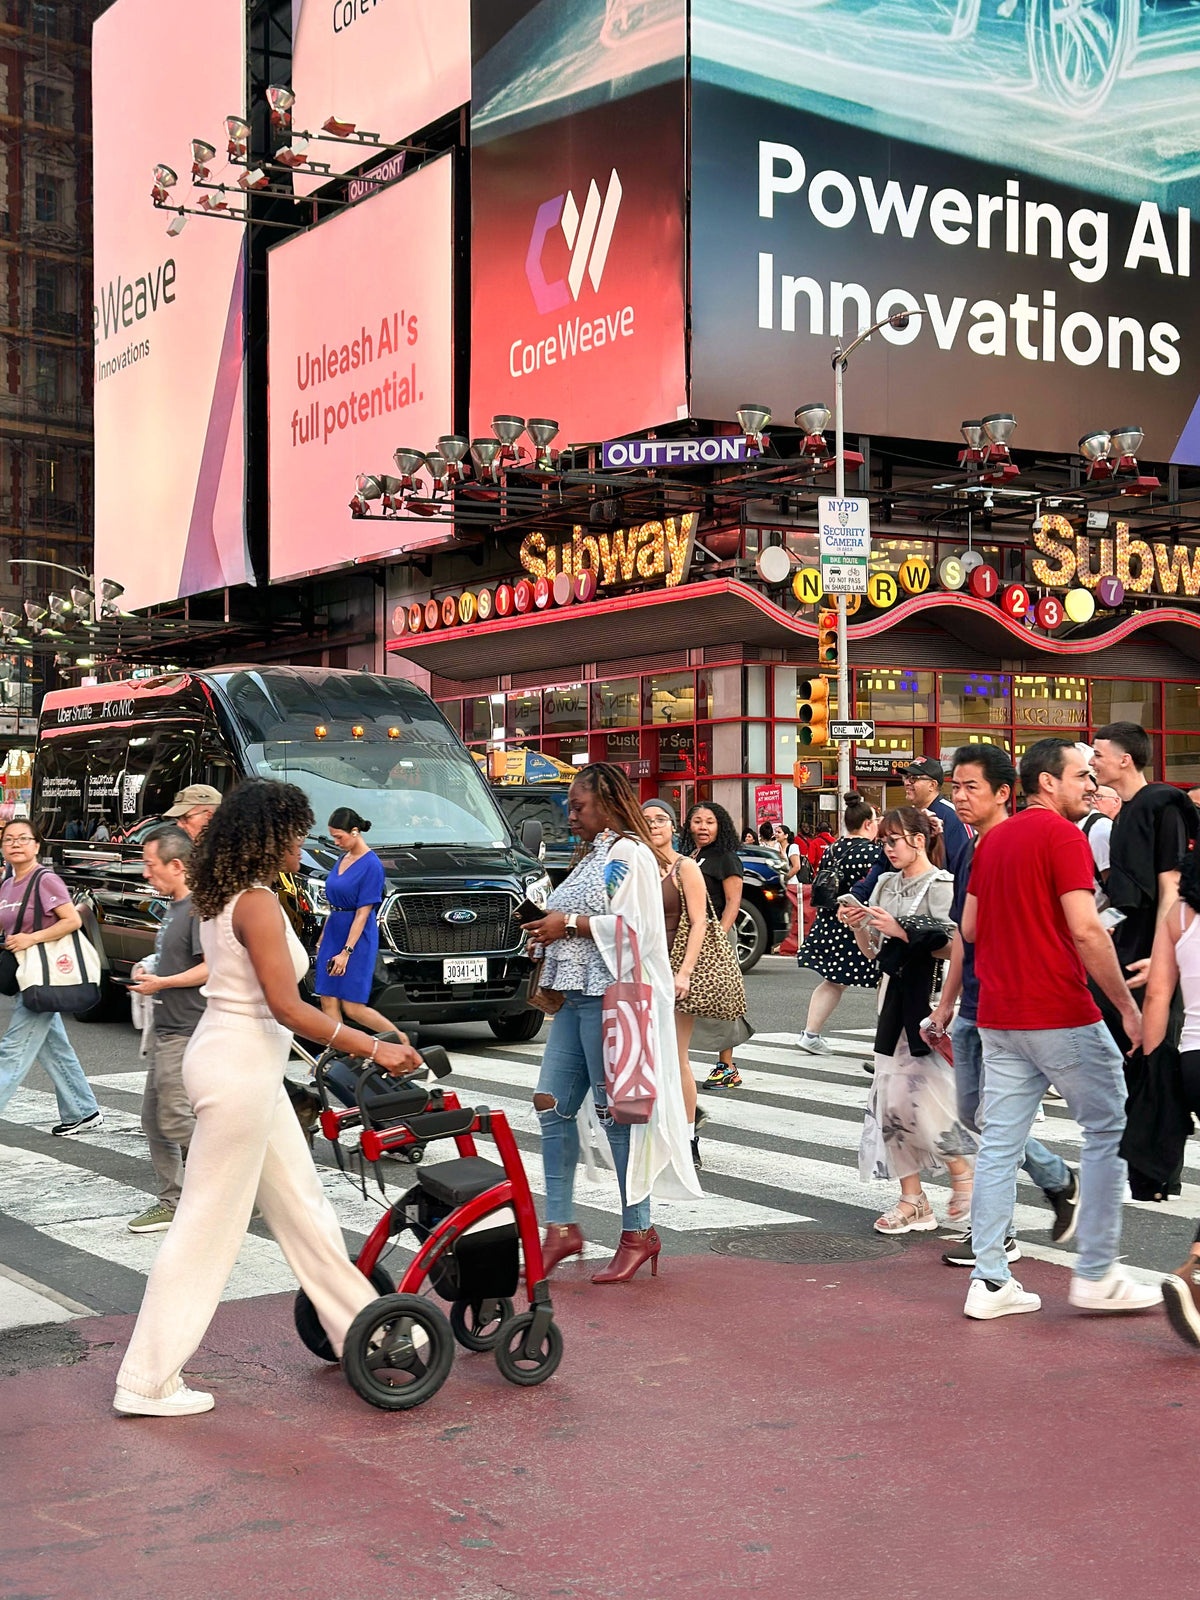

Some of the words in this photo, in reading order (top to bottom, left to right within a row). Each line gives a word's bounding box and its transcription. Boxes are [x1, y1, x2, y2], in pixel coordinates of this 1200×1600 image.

[333, 0, 380, 33] Core
[758, 140, 1109, 283] Powering
[1123, 200, 1191, 277] AI
[509, 306, 635, 378] CoreWeave
[758, 252, 1181, 376] Innovations
[98, 339, 150, 381] Innovations
[297, 326, 373, 391] Unleash
[377, 309, 419, 359] AI's
[291, 401, 320, 447] full
[324, 362, 424, 445] potential.
[823, 525, 865, 536] SECURITY
[828, 501, 859, 512] NYPD
[519, 512, 695, 588] Subway
[826, 536, 864, 547] CAMERA
[802, 574, 819, 596] N
[876, 579, 892, 601] R
[905, 565, 928, 590] W
[945, 562, 962, 584] S
[1011, 589, 1025, 613] 2
[1044, 601, 1058, 624] 3
[1106, 579, 1119, 601] 7
[57, 707, 72, 723] Uber
[72, 704, 93, 721] Shuttle
[119, 699, 135, 717] NYC
